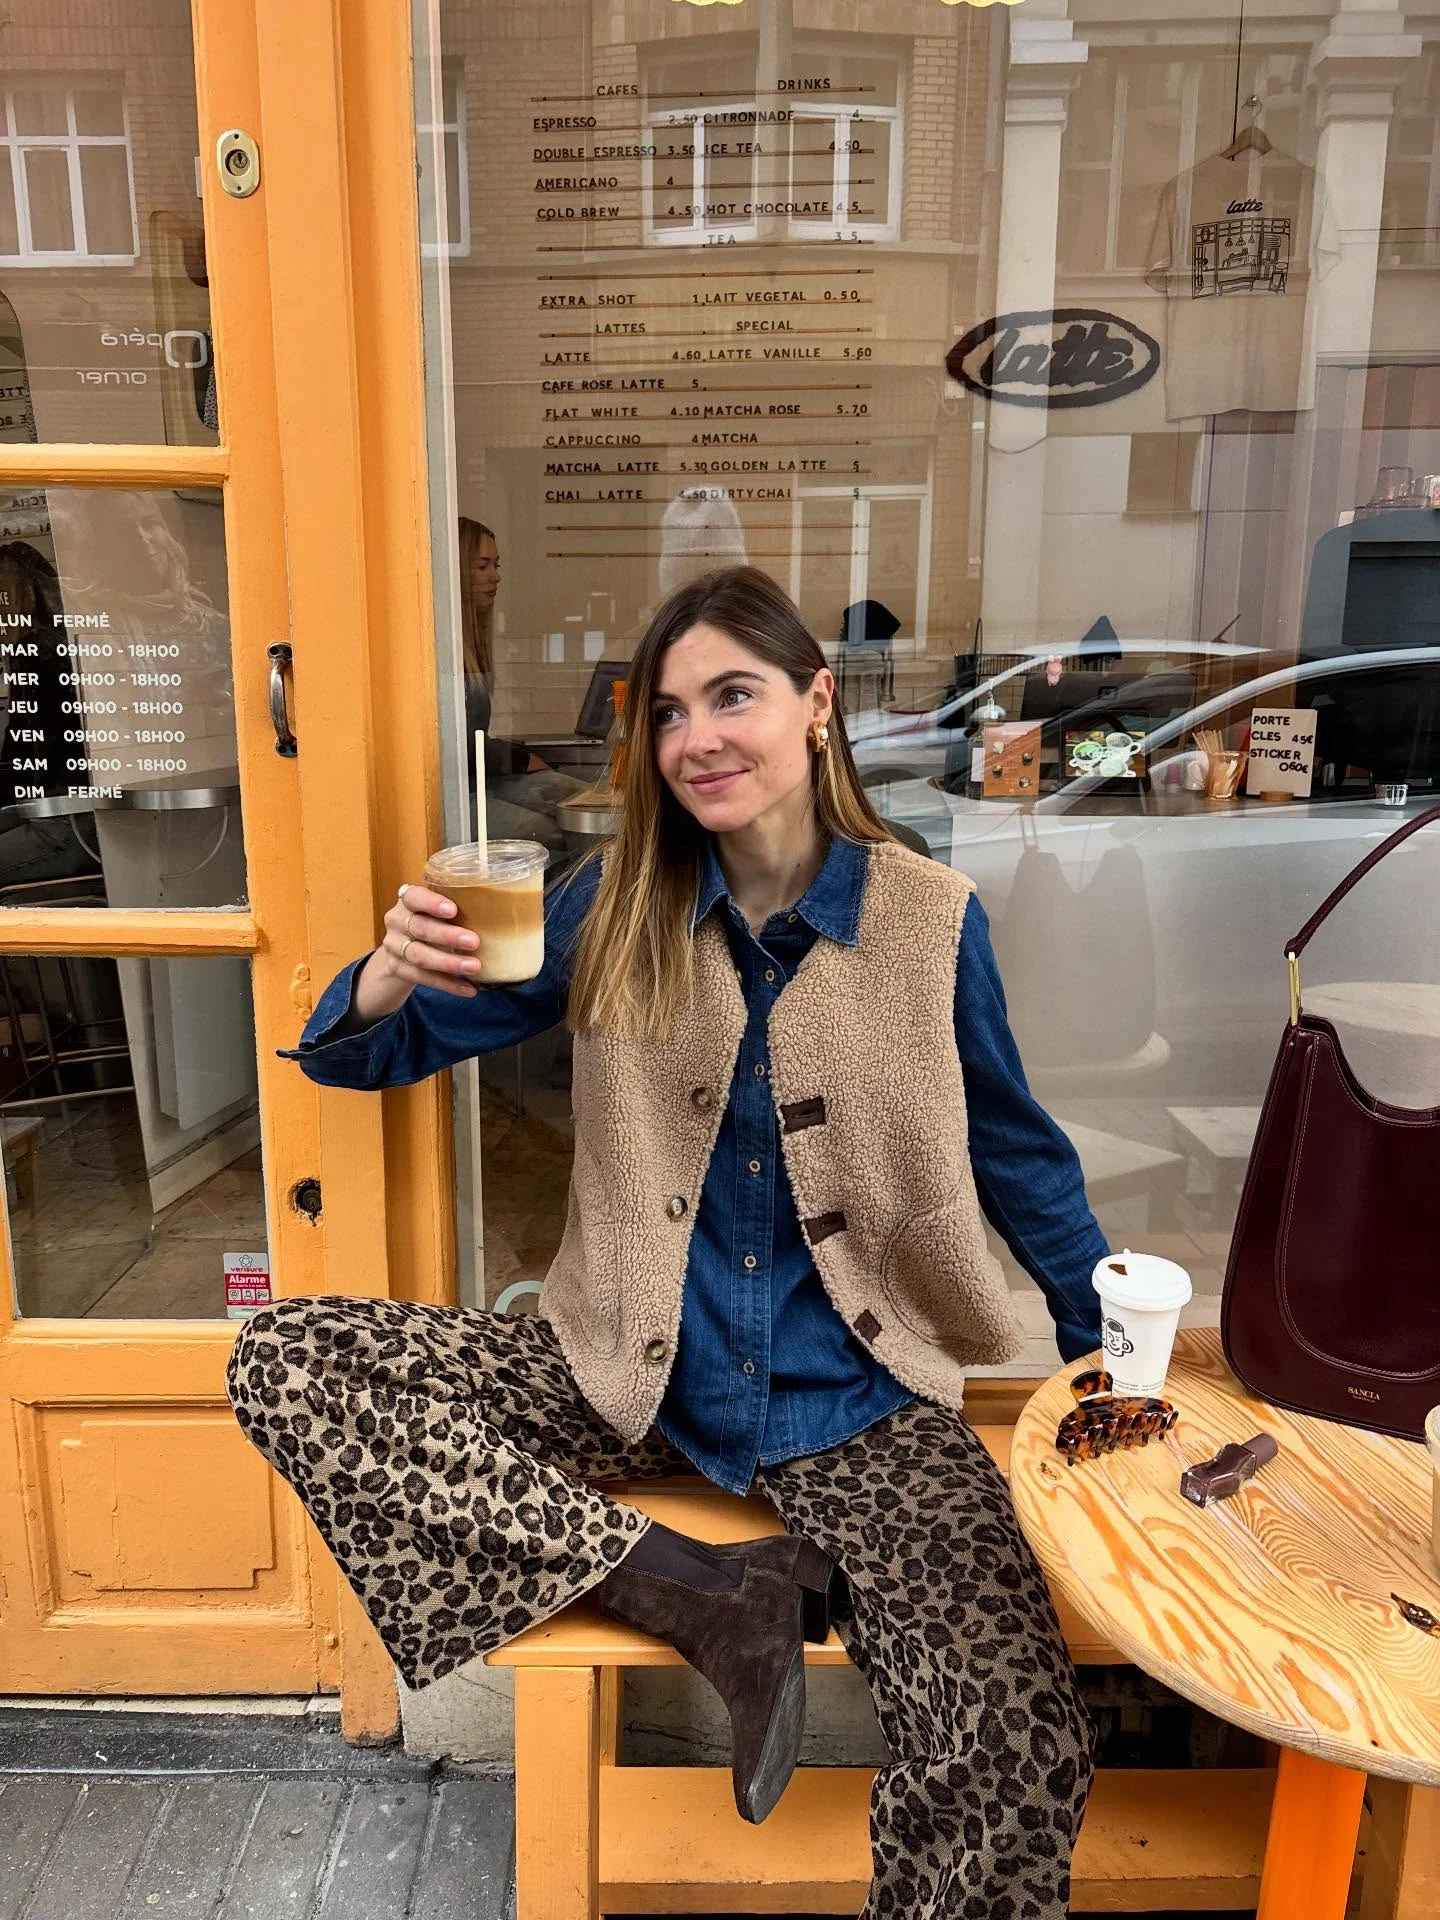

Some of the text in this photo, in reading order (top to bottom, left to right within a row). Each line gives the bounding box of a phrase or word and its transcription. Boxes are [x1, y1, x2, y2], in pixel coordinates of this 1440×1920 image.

[597, 85, 638, 96] CAFES
[777, 78, 831, 91] DRINKS
[533, 117, 597, 129] ESPRESSO
[703, 109, 860, 124] CITRONNADE 4
[533, 145, 697, 160] DOUBLE ESPRESSO 3.50
[705, 140, 860, 155] ICE TEA 4.50
[535, 176, 674, 189] AMERICANO 4
[537, 205, 701, 219] COLD BREW 4.50
[706, 203, 737, 215] HOT
[743, 202, 829, 214] CHOCOLATE
[707, 234, 737, 245] TEA
[541, 295, 586, 306] EXTRA
[598, 294, 637, 305] SHOT
[705, 290, 859, 303] LAIT VEGETAL 0.50
[596, 323, 646, 334] LATTES
[736, 320, 794, 331] SPECIAL
[545, 350, 701, 363] LATTE 4.60
[709, 347, 872, 360] LATTE VANILLE 5.60
[542, 381, 574, 391] CAFE
[582, 379, 613, 390] ROSE
[621, 379, 665, 389] LATTE
[545, 406, 700, 418] FLAT WHITE 4.10
[704, 403, 868, 416] MATCHA ROSE 5.70
[545, 434, 698, 446] CAPPUCCINO 4
[702, 433, 758, 444] MATCHA
[546, 461, 708, 473] MATCHA LATTE 5.30
[711, 460, 769, 472] GOLDEN
[778, 459, 827, 471] LATTE
[545, 490, 580, 501] CHAI
[598, 489, 643, 500] LATTE
[0, 612, 110, 628] LUN FERMÉ
[0, 643, 39, 657] MAR
[56, 644, 113, 657] 09H00
[128, 644, 180, 657] 18H00
[3, 673, 40, 686] MER
[58, 673, 115, 686] 09H00
[130, 673, 182, 687] 18H00
[7, 701, 39, 714] JEU
[61, 701, 117, 714] 09H00
[132, 702, 183, 715] 18H00
[1253, 715, 1291, 726] PORTE
[10, 729, 44, 742] VEN
[63, 730, 119, 743] 09H00
[134, 730, 185, 743] 18H00
[1251, 731, 1281, 741] CLES
[1250, 748, 1301, 760] STICKER
[12, 758, 48, 771] SAM
[66, 758, 121, 771] 09H00
[136, 759, 187, 772] 18H00
[14, 784, 123, 799] DIM FERMÉ
[229, 1275, 266, 1284] Alarme
